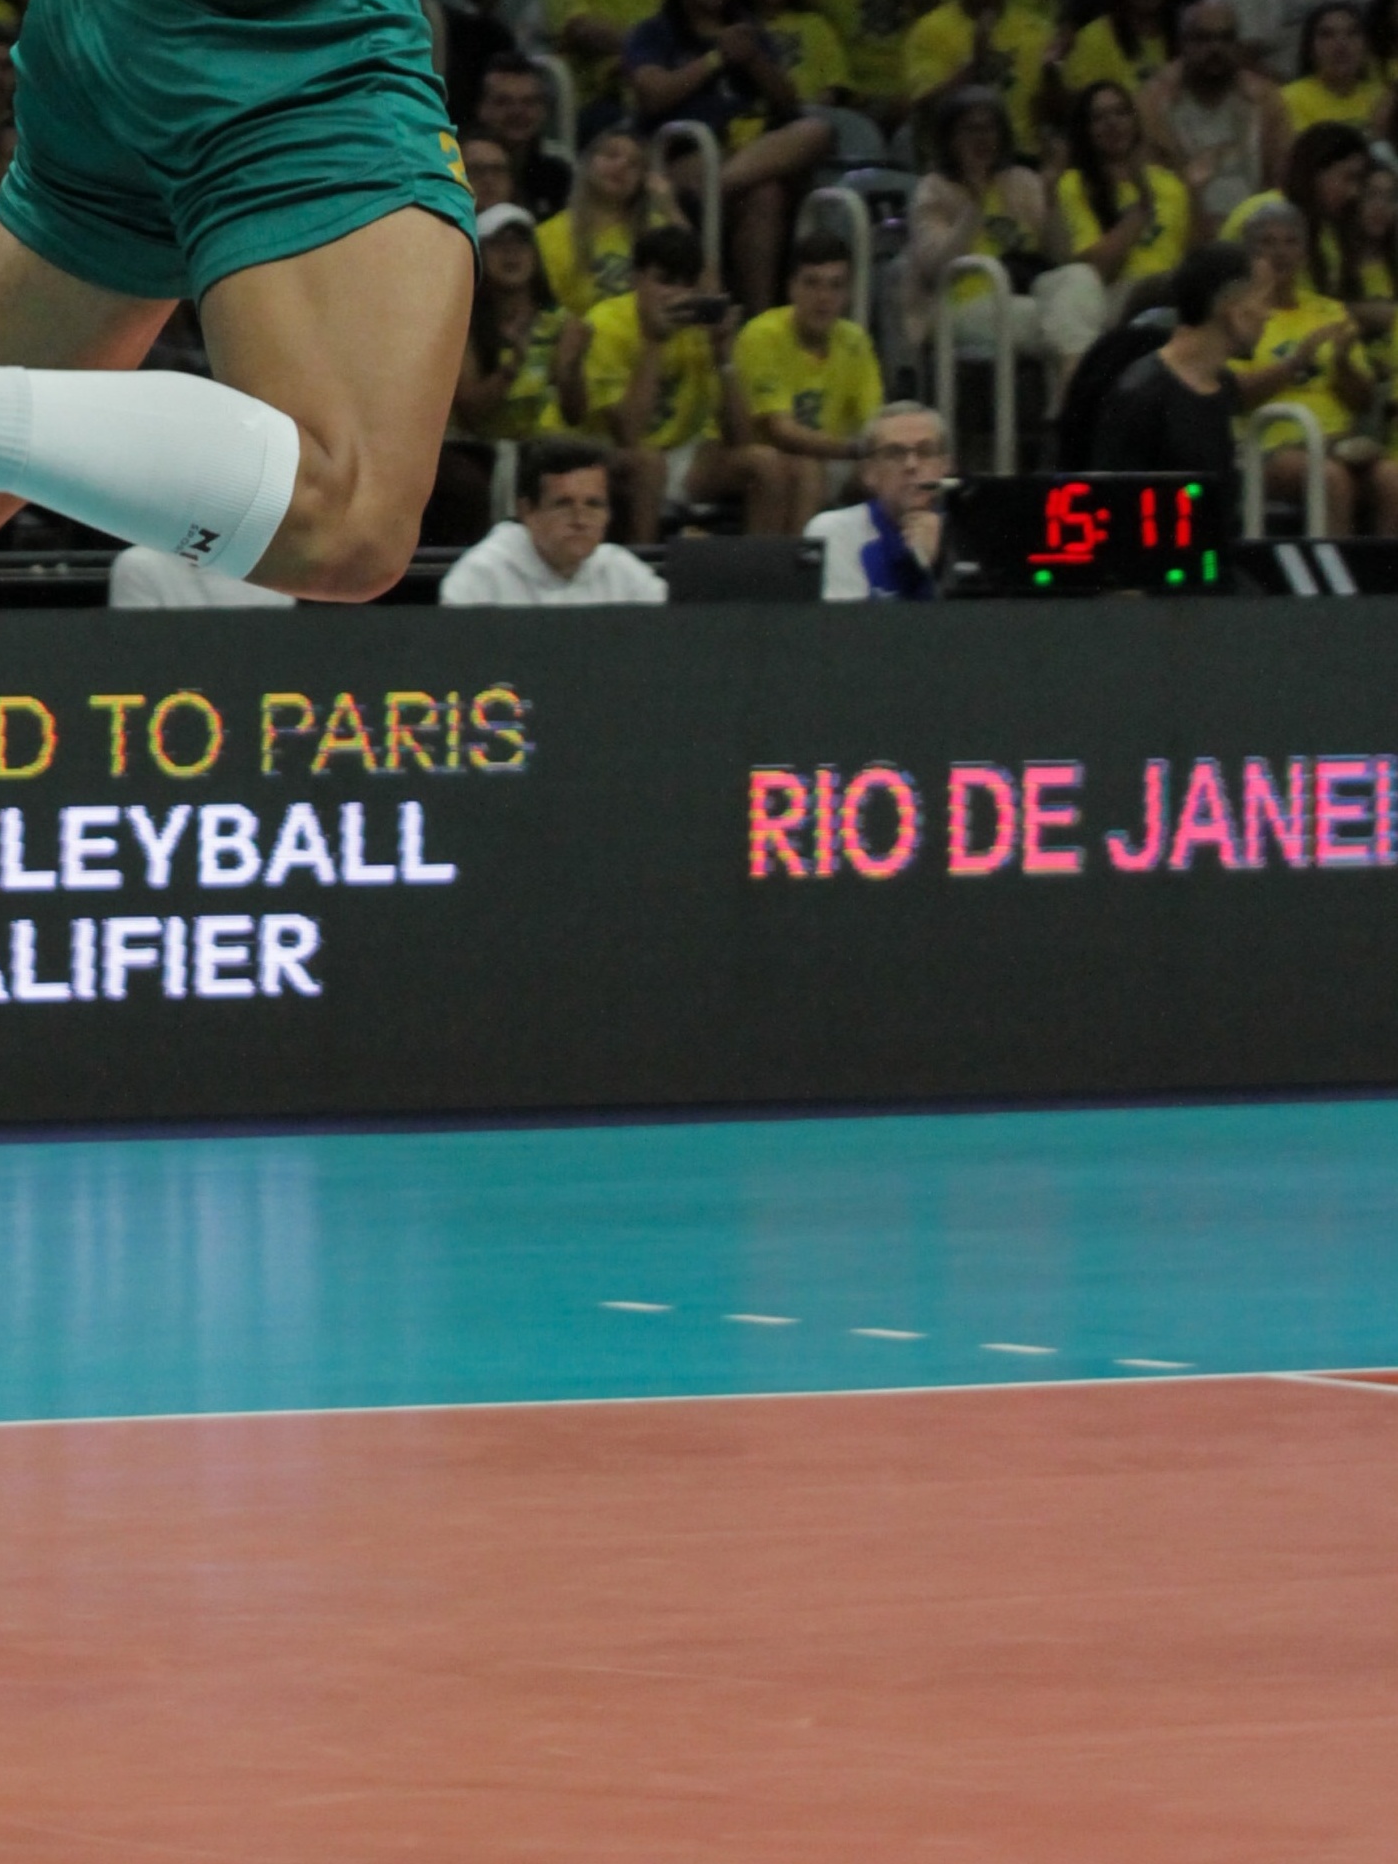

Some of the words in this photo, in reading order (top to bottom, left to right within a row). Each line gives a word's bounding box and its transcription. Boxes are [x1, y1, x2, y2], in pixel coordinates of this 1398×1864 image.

[89, 691, 223, 778] TO
[261, 684, 533, 774] PARIS
[748, 764, 922, 879] RIO
[947, 761, 1083, 875] DE
